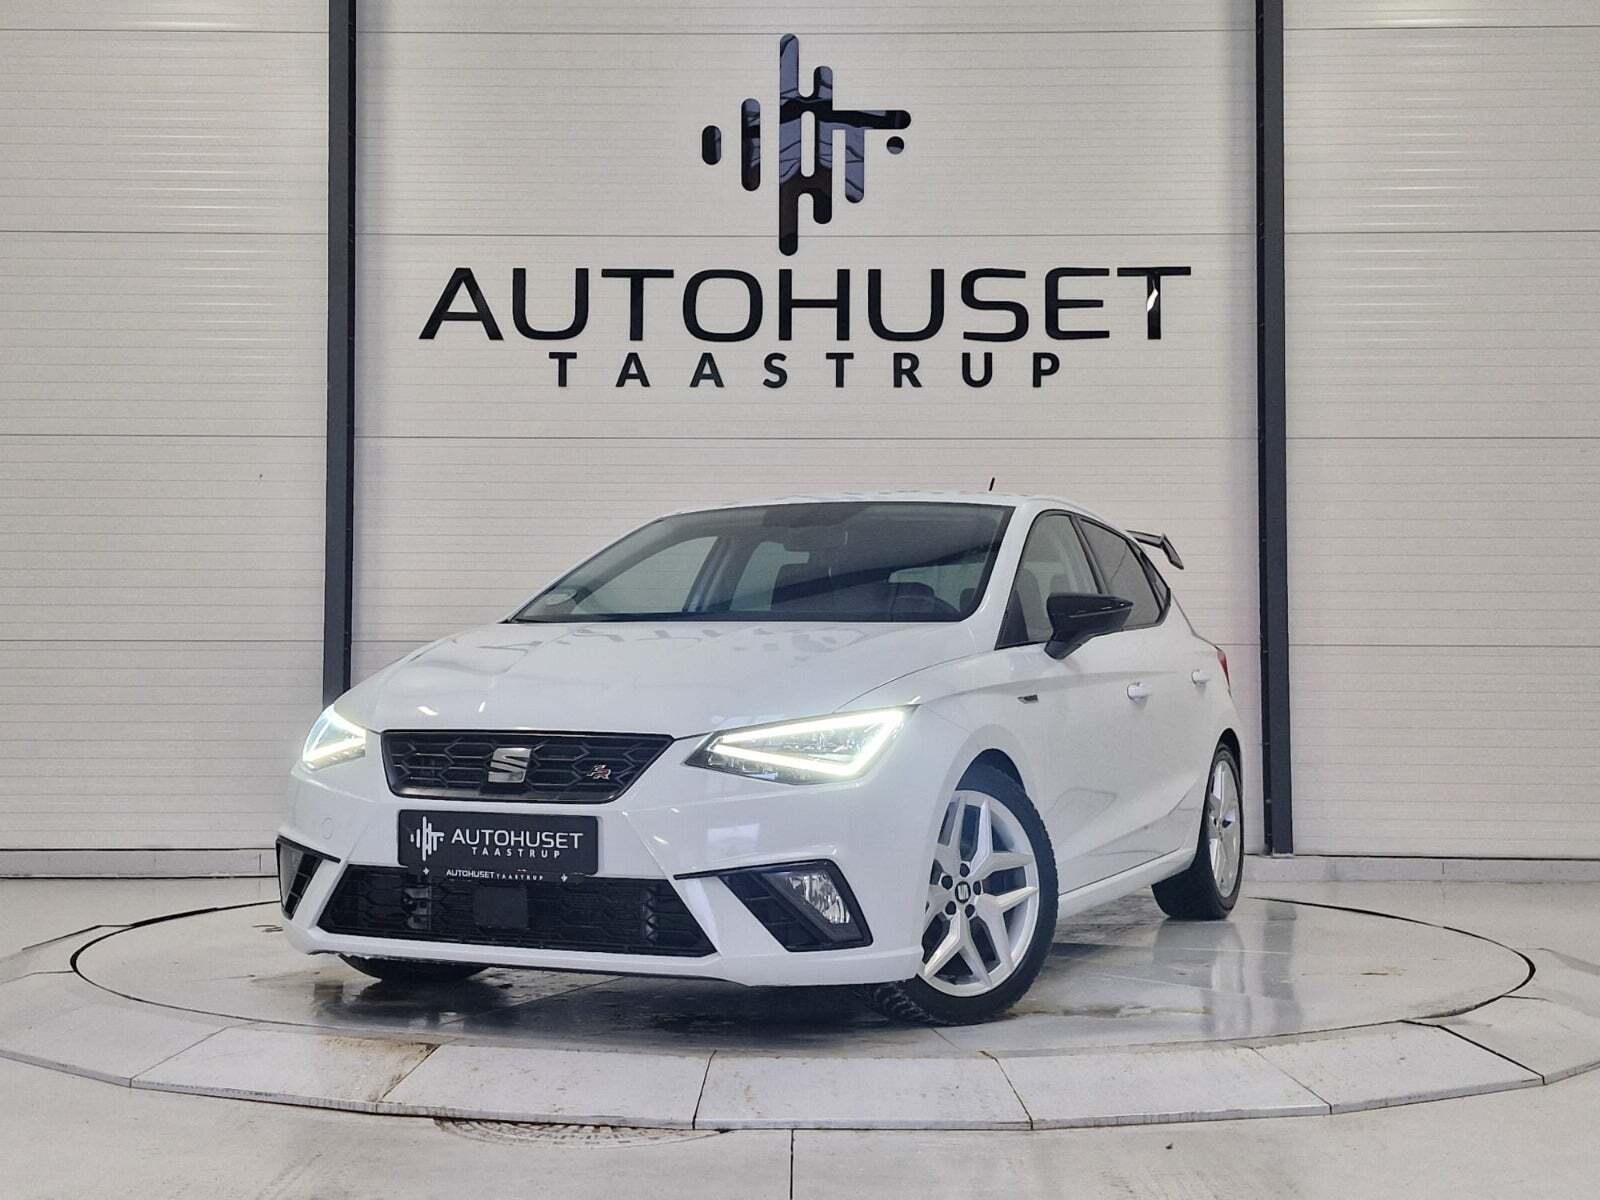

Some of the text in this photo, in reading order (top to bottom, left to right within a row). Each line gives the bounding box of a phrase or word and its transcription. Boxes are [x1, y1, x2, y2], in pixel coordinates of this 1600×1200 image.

[418, 266, 1192, 342] AUTOHUSET
[548, 351, 1061, 388] TAASTRUP
[451, 828, 584, 849] AUTOHUSET
[471, 846, 561, 859] TAASTRUP
[446, 868, 495, 879] AUTOHUSET
